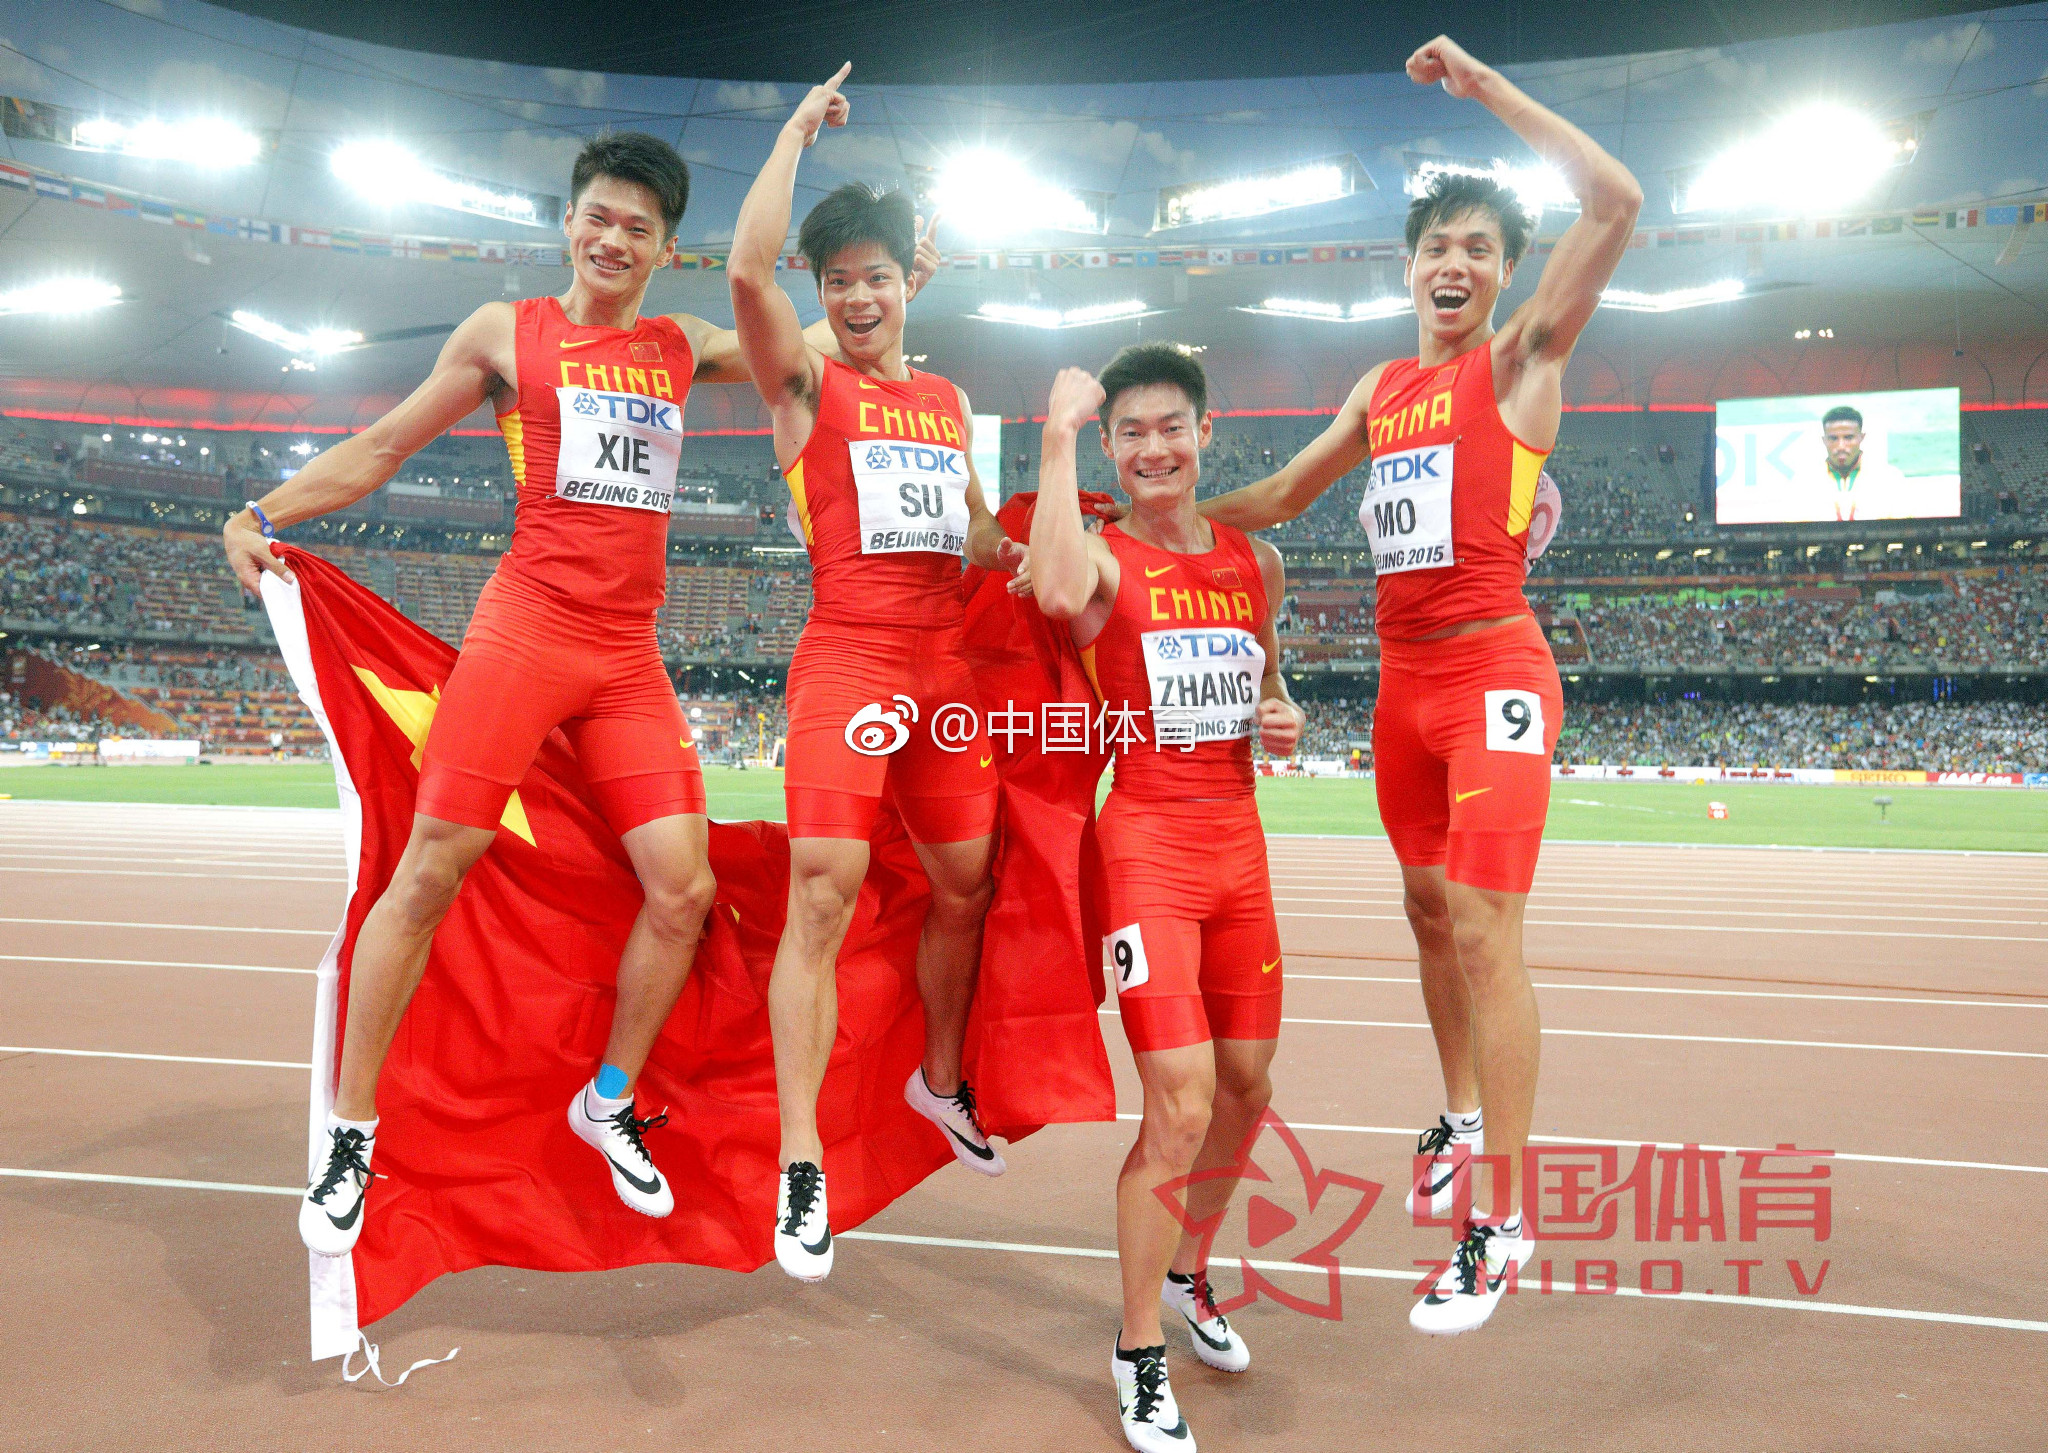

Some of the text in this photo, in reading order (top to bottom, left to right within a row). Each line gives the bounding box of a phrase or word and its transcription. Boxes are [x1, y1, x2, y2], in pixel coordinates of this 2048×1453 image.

[560, 361, 673, 399] CHINA
[597, 394, 673, 431] TDK
[859, 401, 961, 446] CHINA
[1370, 390, 1453, 451] CHINA
[594, 432, 650, 475] XIE
[889, 445, 962, 475] TDK
[1377, 451, 1440, 487] TDK
[563, 480, 672, 510] BEIJING 2015
[899, 482, 944, 519] SU
[1374, 498, 1416, 539] MO
[869, 531, 940, 550] BEIJING
[1407, 545, 1445, 566] 2015
[1150, 587, 1253, 622] CHINA
[1180, 633, 1255, 657] TDK
[1157, 671, 1253, 707] ZHANG
[1502, 698, 1531, 741] 9
[1114, 940, 1133, 981] 9
